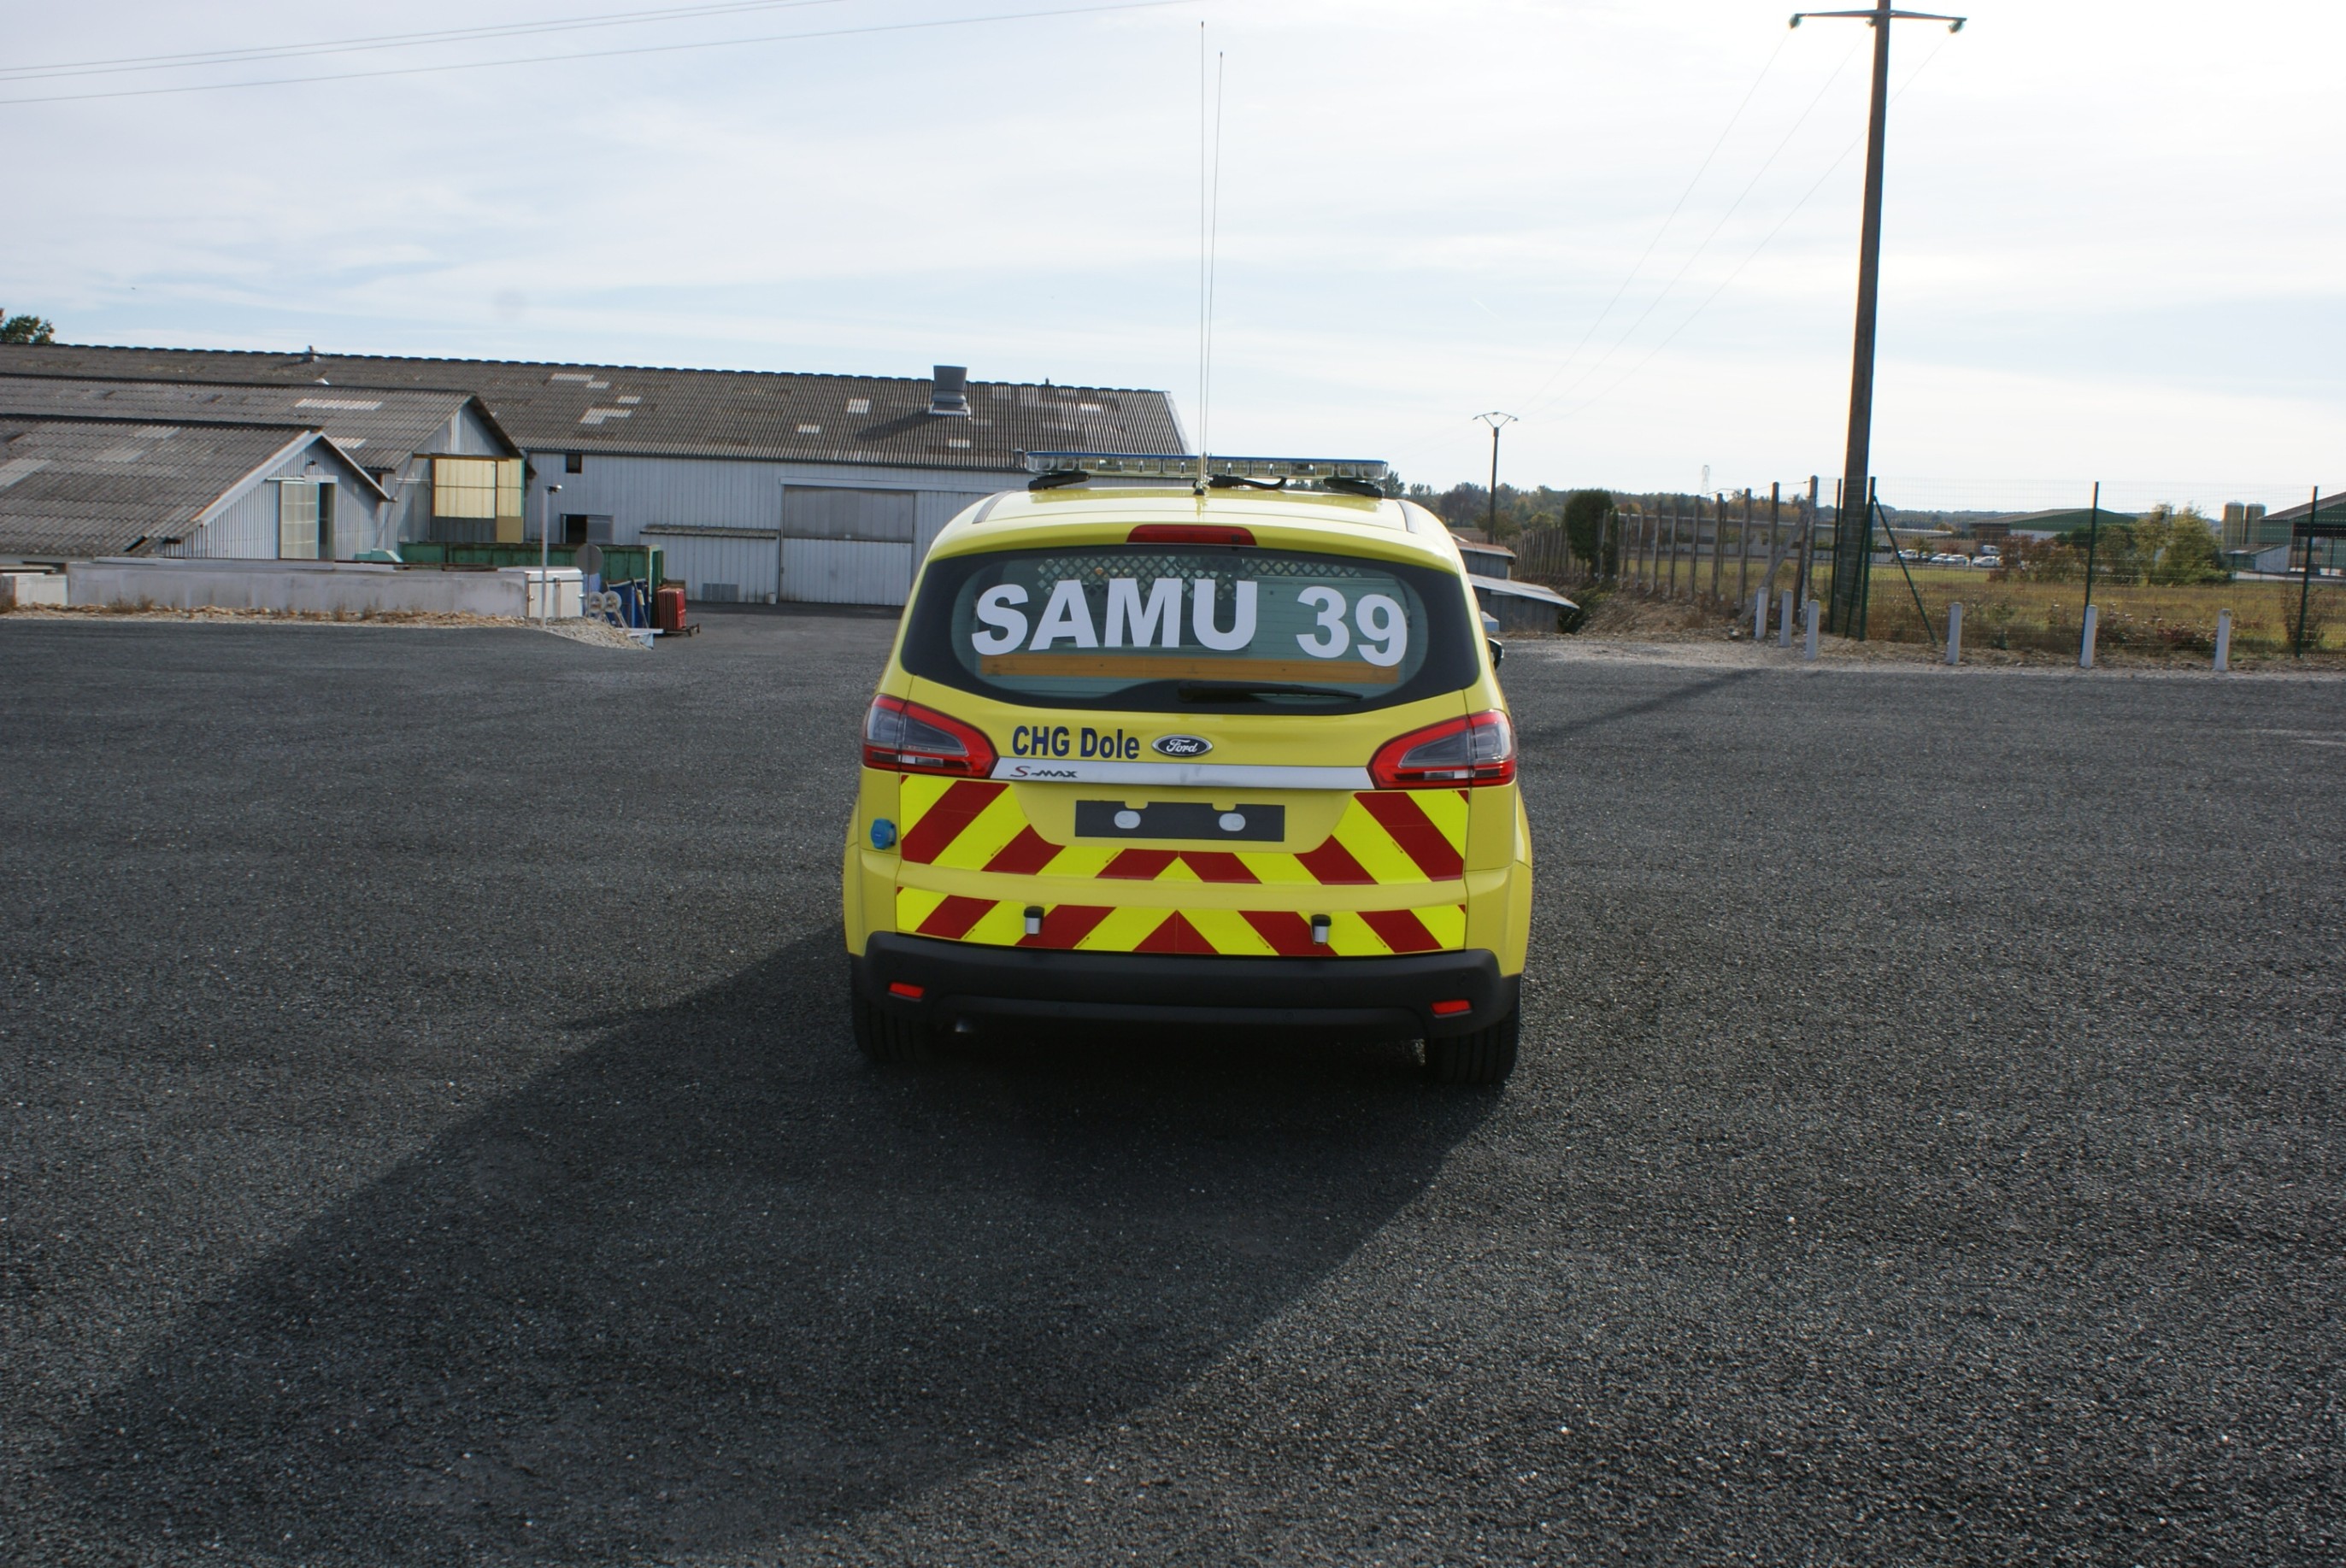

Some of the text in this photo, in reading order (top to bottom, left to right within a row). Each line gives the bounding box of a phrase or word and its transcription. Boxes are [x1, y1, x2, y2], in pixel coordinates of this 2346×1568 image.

[971, 577, 1408, 667] SAMU 39
[1012, 725, 1139, 760] CHG Dole
[1165, 737, 1198, 754] Ford
